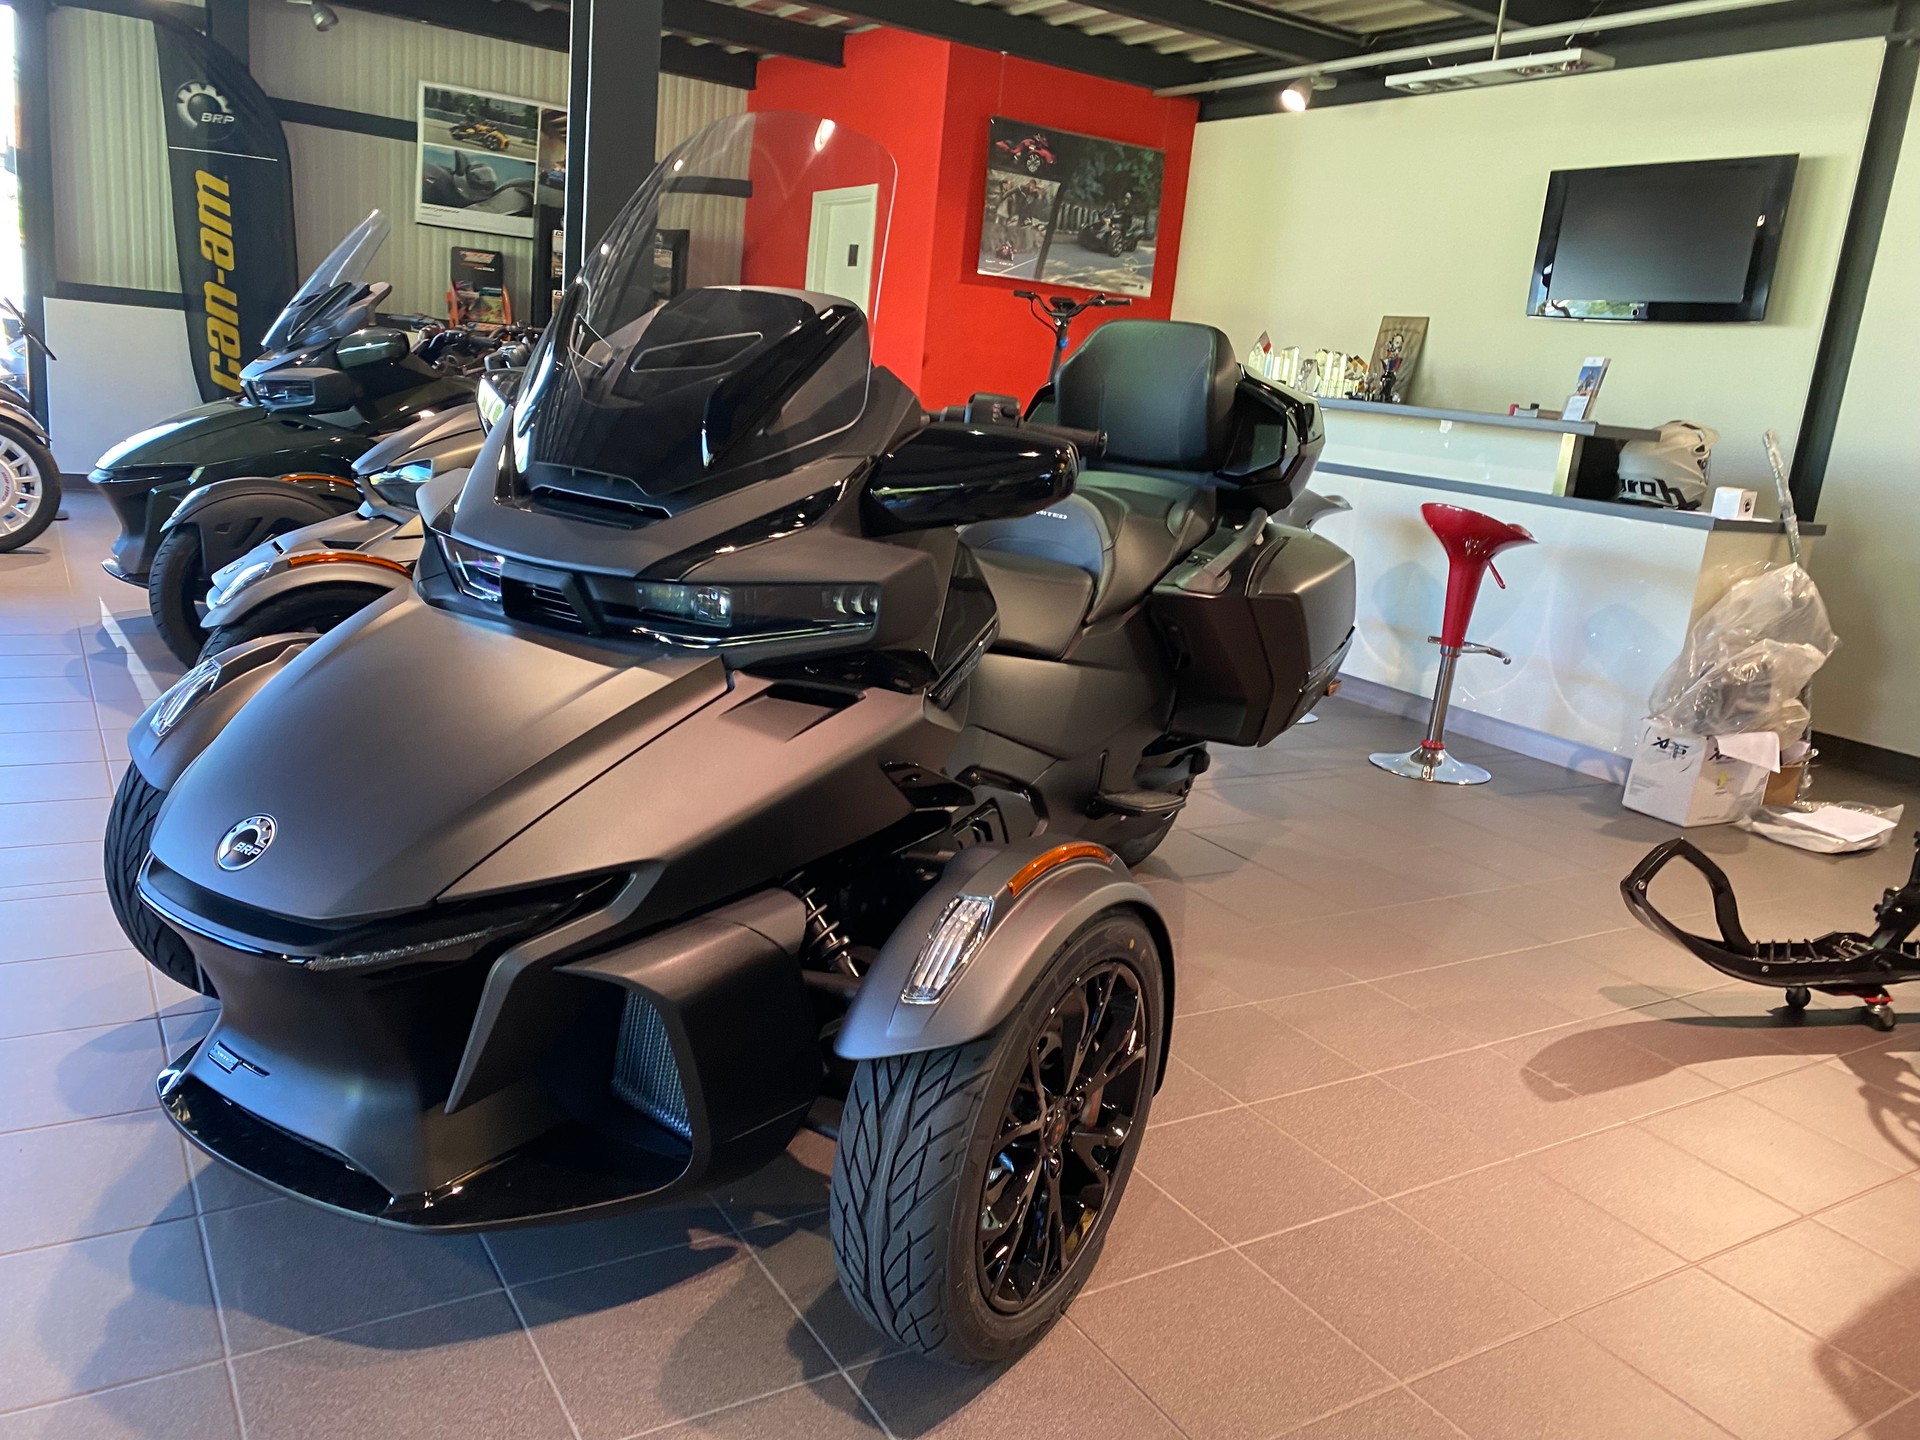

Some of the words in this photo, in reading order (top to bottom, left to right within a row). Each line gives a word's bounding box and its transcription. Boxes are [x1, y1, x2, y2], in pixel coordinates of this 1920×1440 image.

[201, 112, 235, 125] BRP
[195, 169, 243, 393] can-am
[232, 841, 262, 856] BRP
